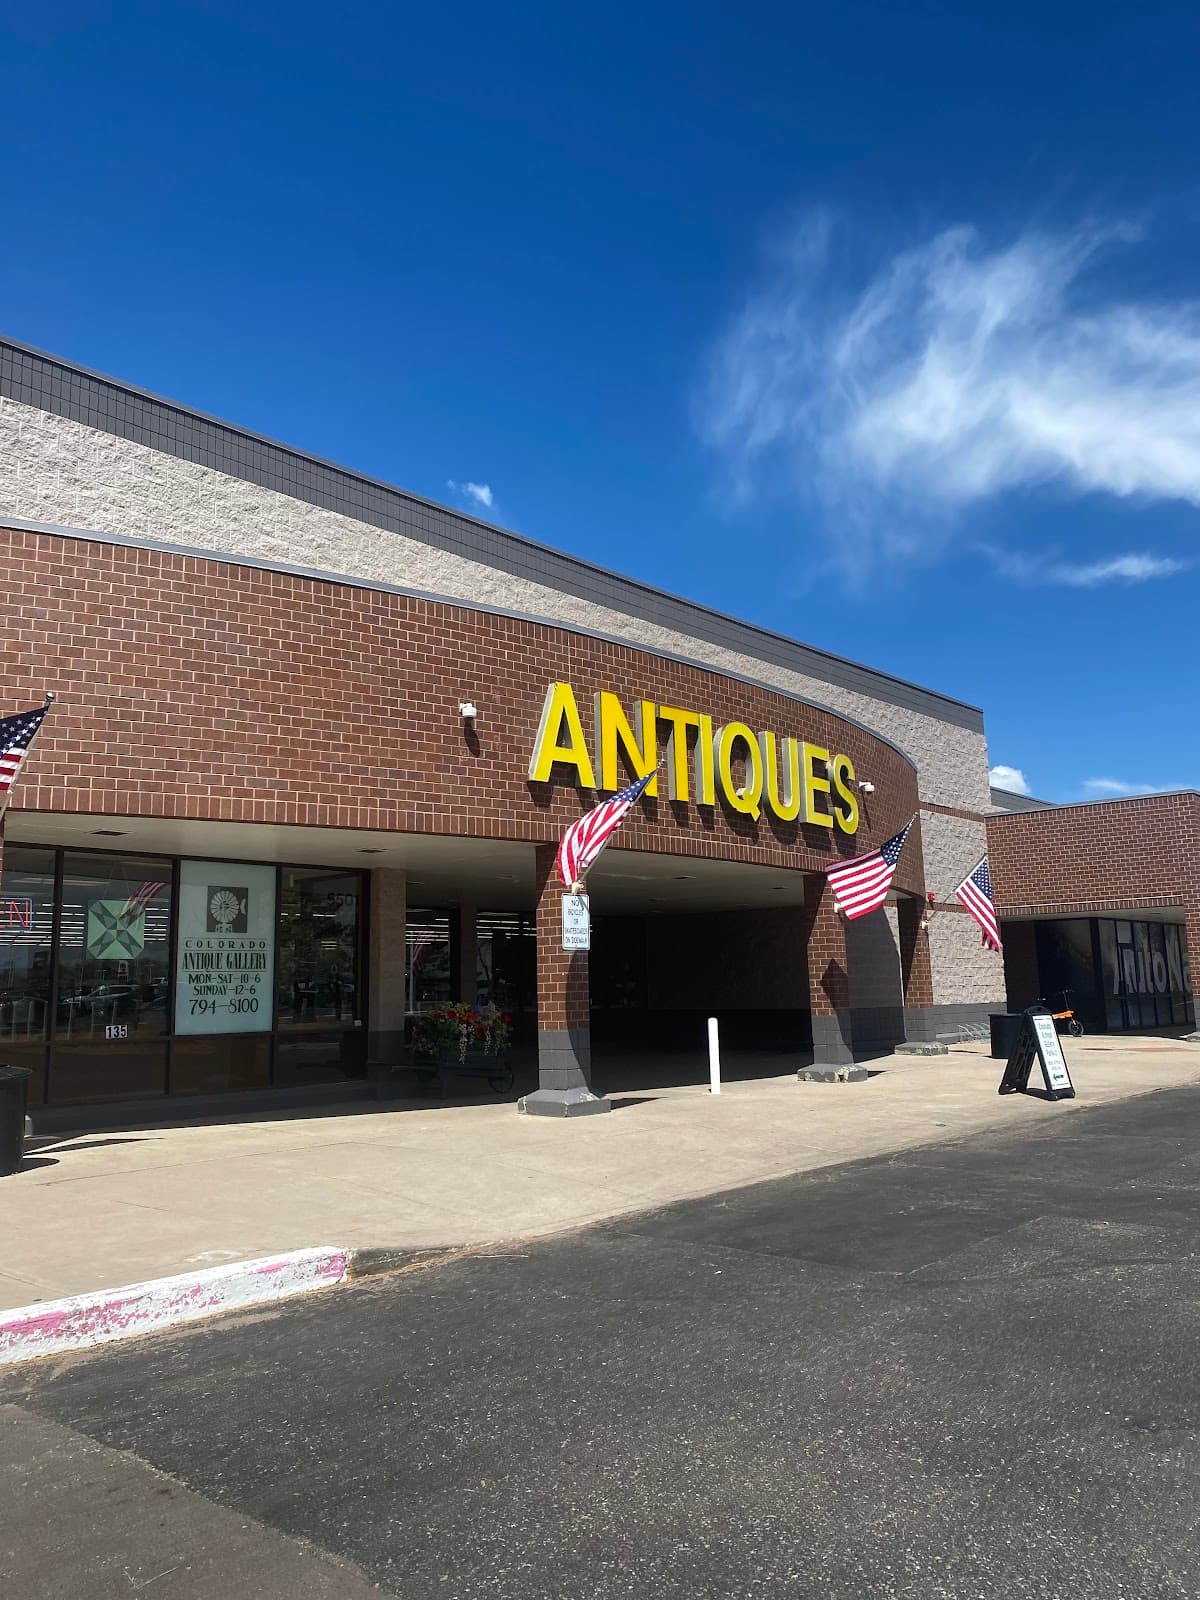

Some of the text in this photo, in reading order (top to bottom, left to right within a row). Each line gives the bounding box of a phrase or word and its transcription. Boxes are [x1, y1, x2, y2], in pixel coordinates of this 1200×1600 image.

[528, 681, 859, 836] ANTIQUES
[571, 899, 580, 907] NO
[185, 940, 266, 948] COLORADO
[183, 952, 267, 970] ANTIQUE GALLERY
[189, 998, 259, 1016] 794-8100
[106, 1025, 127, 1038] 135
